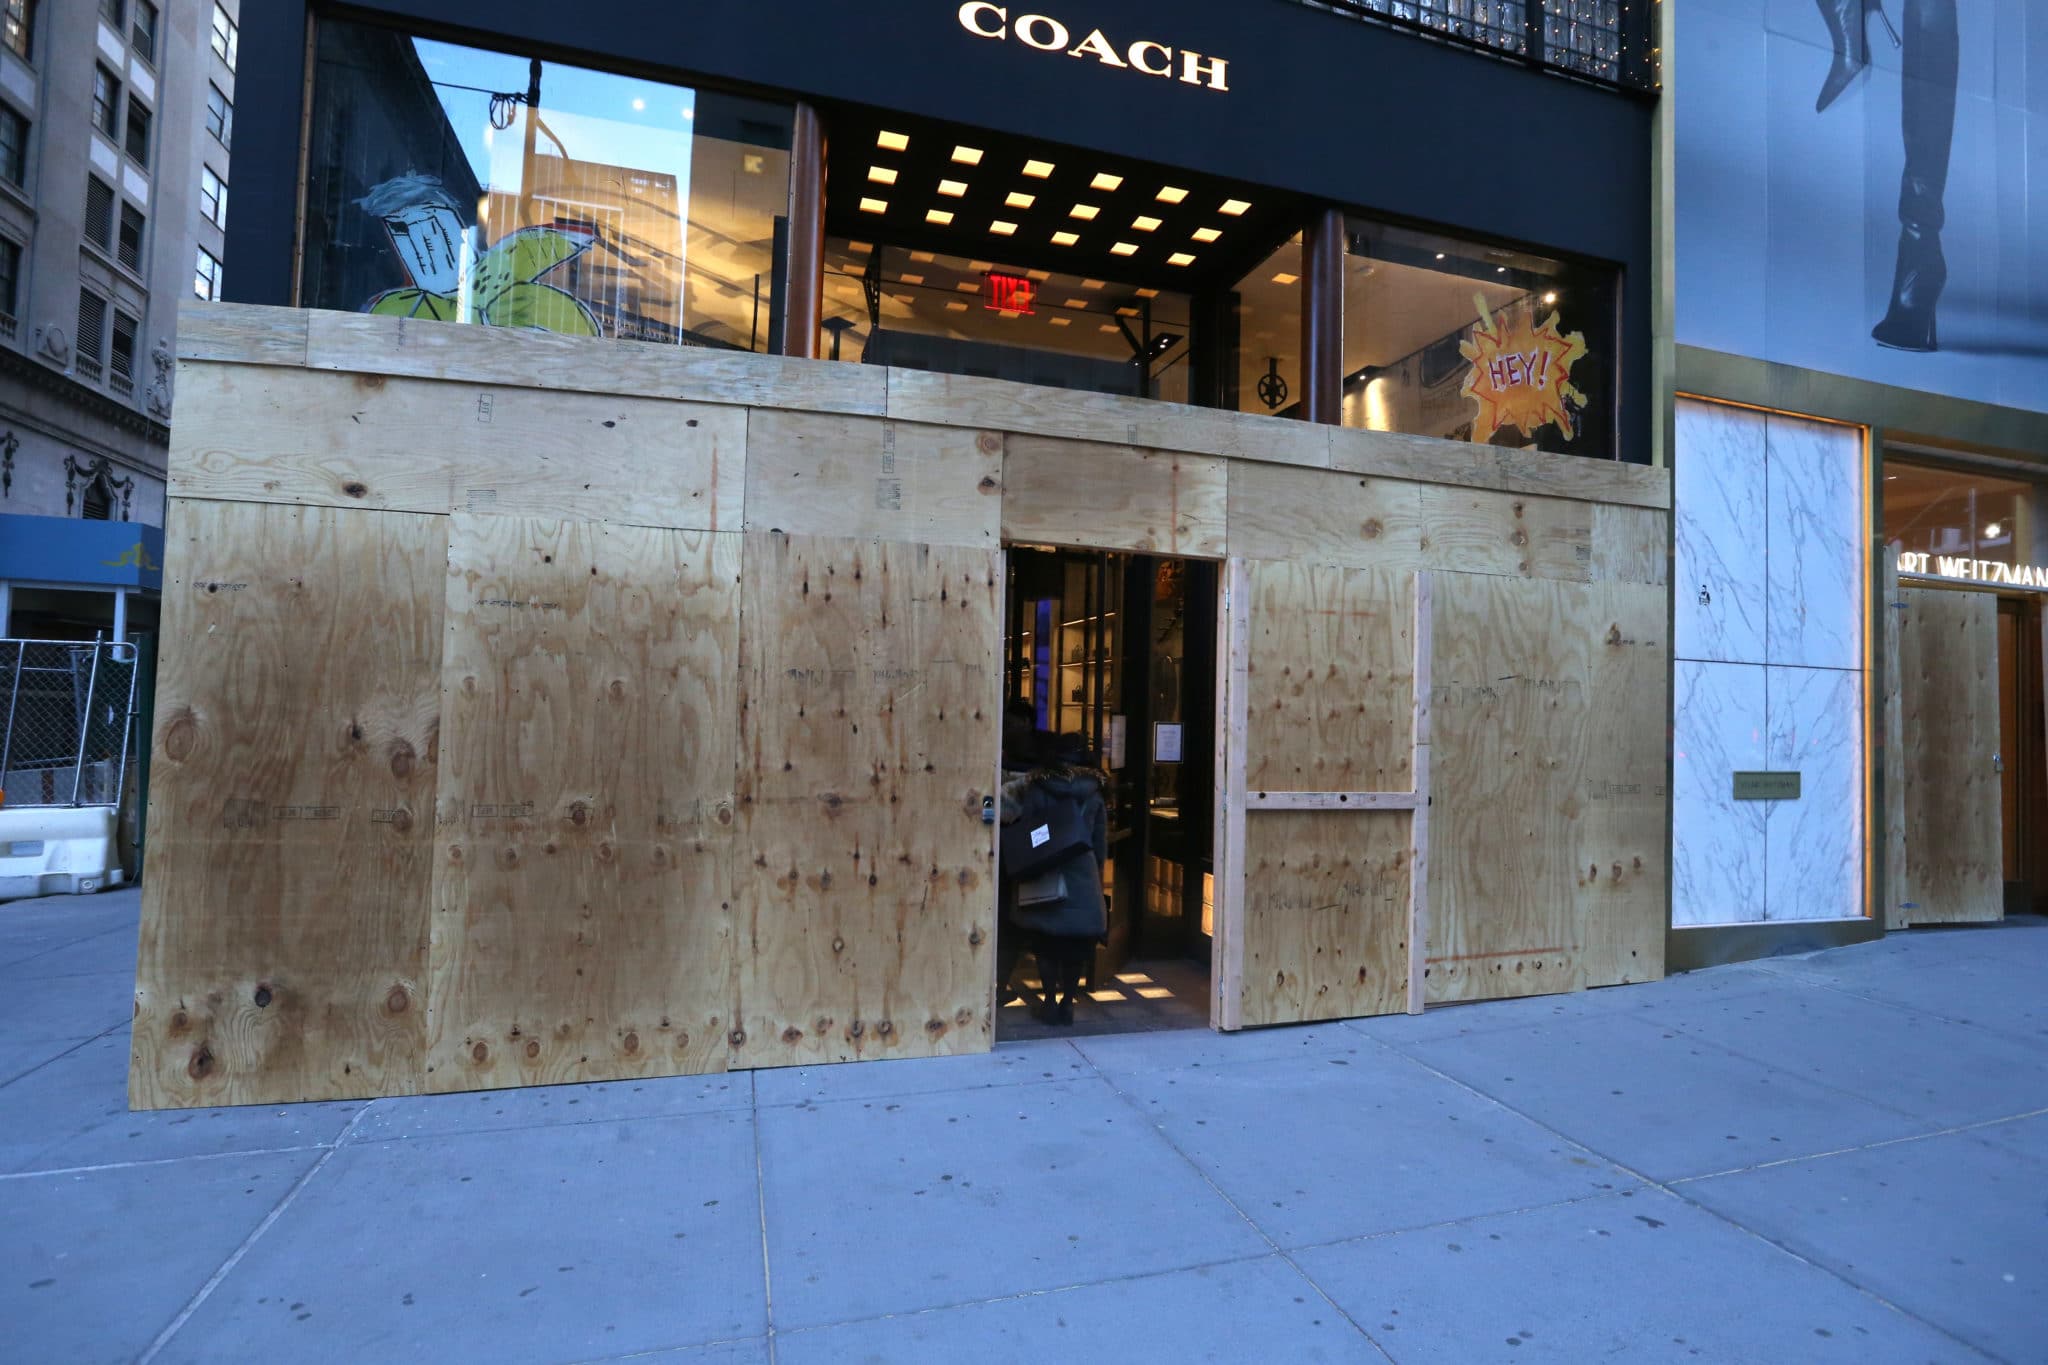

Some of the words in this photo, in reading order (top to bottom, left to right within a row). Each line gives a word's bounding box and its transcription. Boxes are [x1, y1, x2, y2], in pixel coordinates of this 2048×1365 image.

[958, 1, 1230, 92] COACH
[1487, 348, 1550, 391] HEY!
[1937, 555, 2048, 588] WEITZMAN
